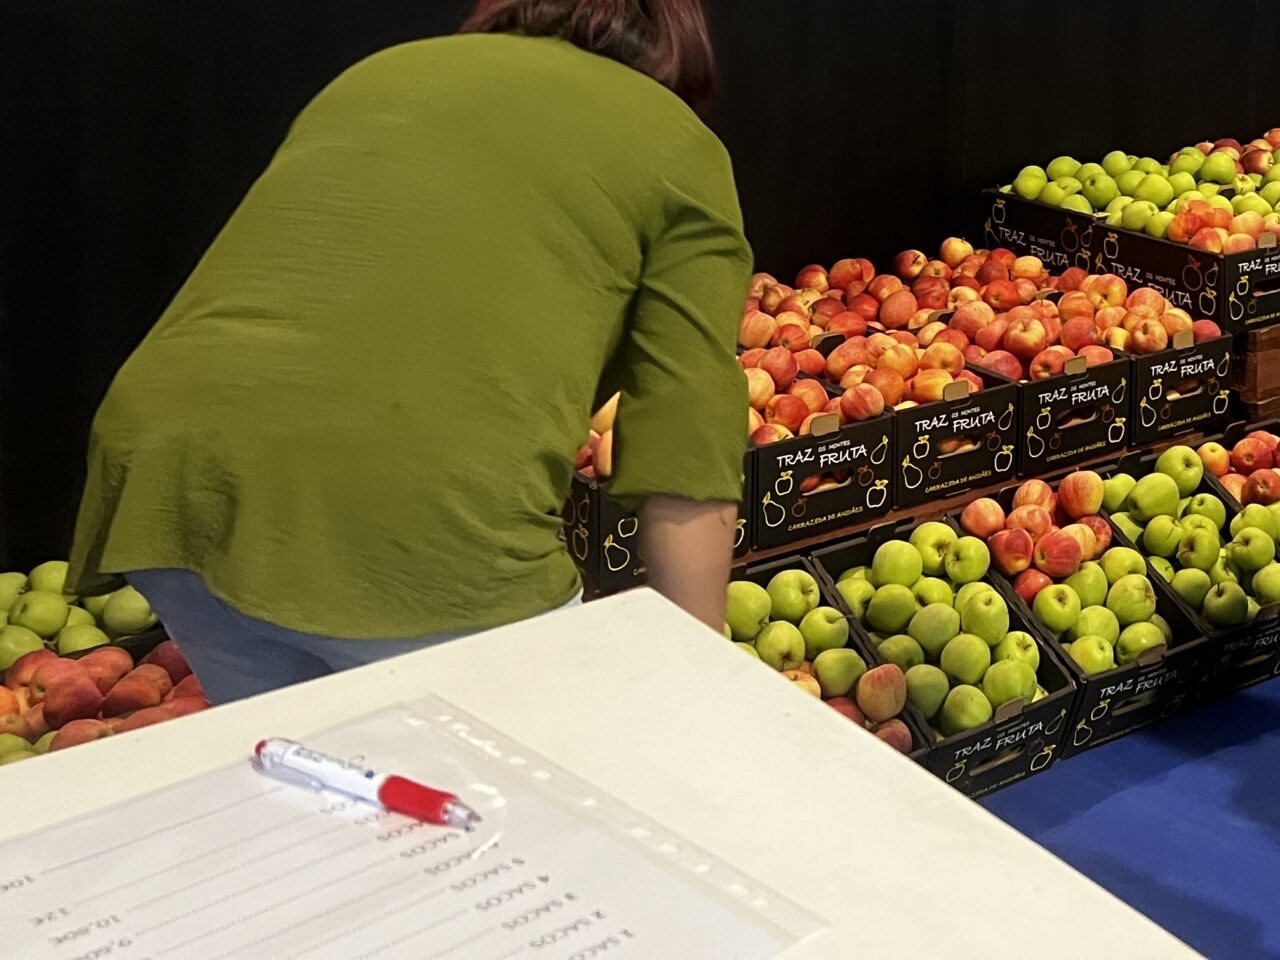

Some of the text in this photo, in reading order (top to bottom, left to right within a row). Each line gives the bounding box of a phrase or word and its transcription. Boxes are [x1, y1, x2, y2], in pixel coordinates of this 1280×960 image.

[999, 227, 1026, 247] TRAZ
[1030, 245, 1069, 268] FRUTA
[1237, 259, 1263, 274] TRAZ
[1111, 262, 1143, 284] TRAZ
[1149, 360, 1178, 377] TRAZ
[1180, 358, 1215, 378] FRUTA
[1038, 387, 1068, 405] TRAZ
[1071, 385, 1109, 405] FRUTA
[915, 414, 949, 433] TRAZ
[953, 411, 995, 433] FRUTA
[776, 447, 815, 468] TRAZ
[820, 444, 867, 468] FRUTA
[1100, 678, 1134, 699] TRAZ
[1135, 669, 1177, 694] FRUTA
[995, 721, 1043, 750] FRUTA
[954, 737, 992, 760] TRAZ
[449, 865, 511, 892] SACOS
[474, 882, 537, 912] SACOS
[501, 900, 563, 931] SACOS
[529, 919, 591, 949] SACOS
